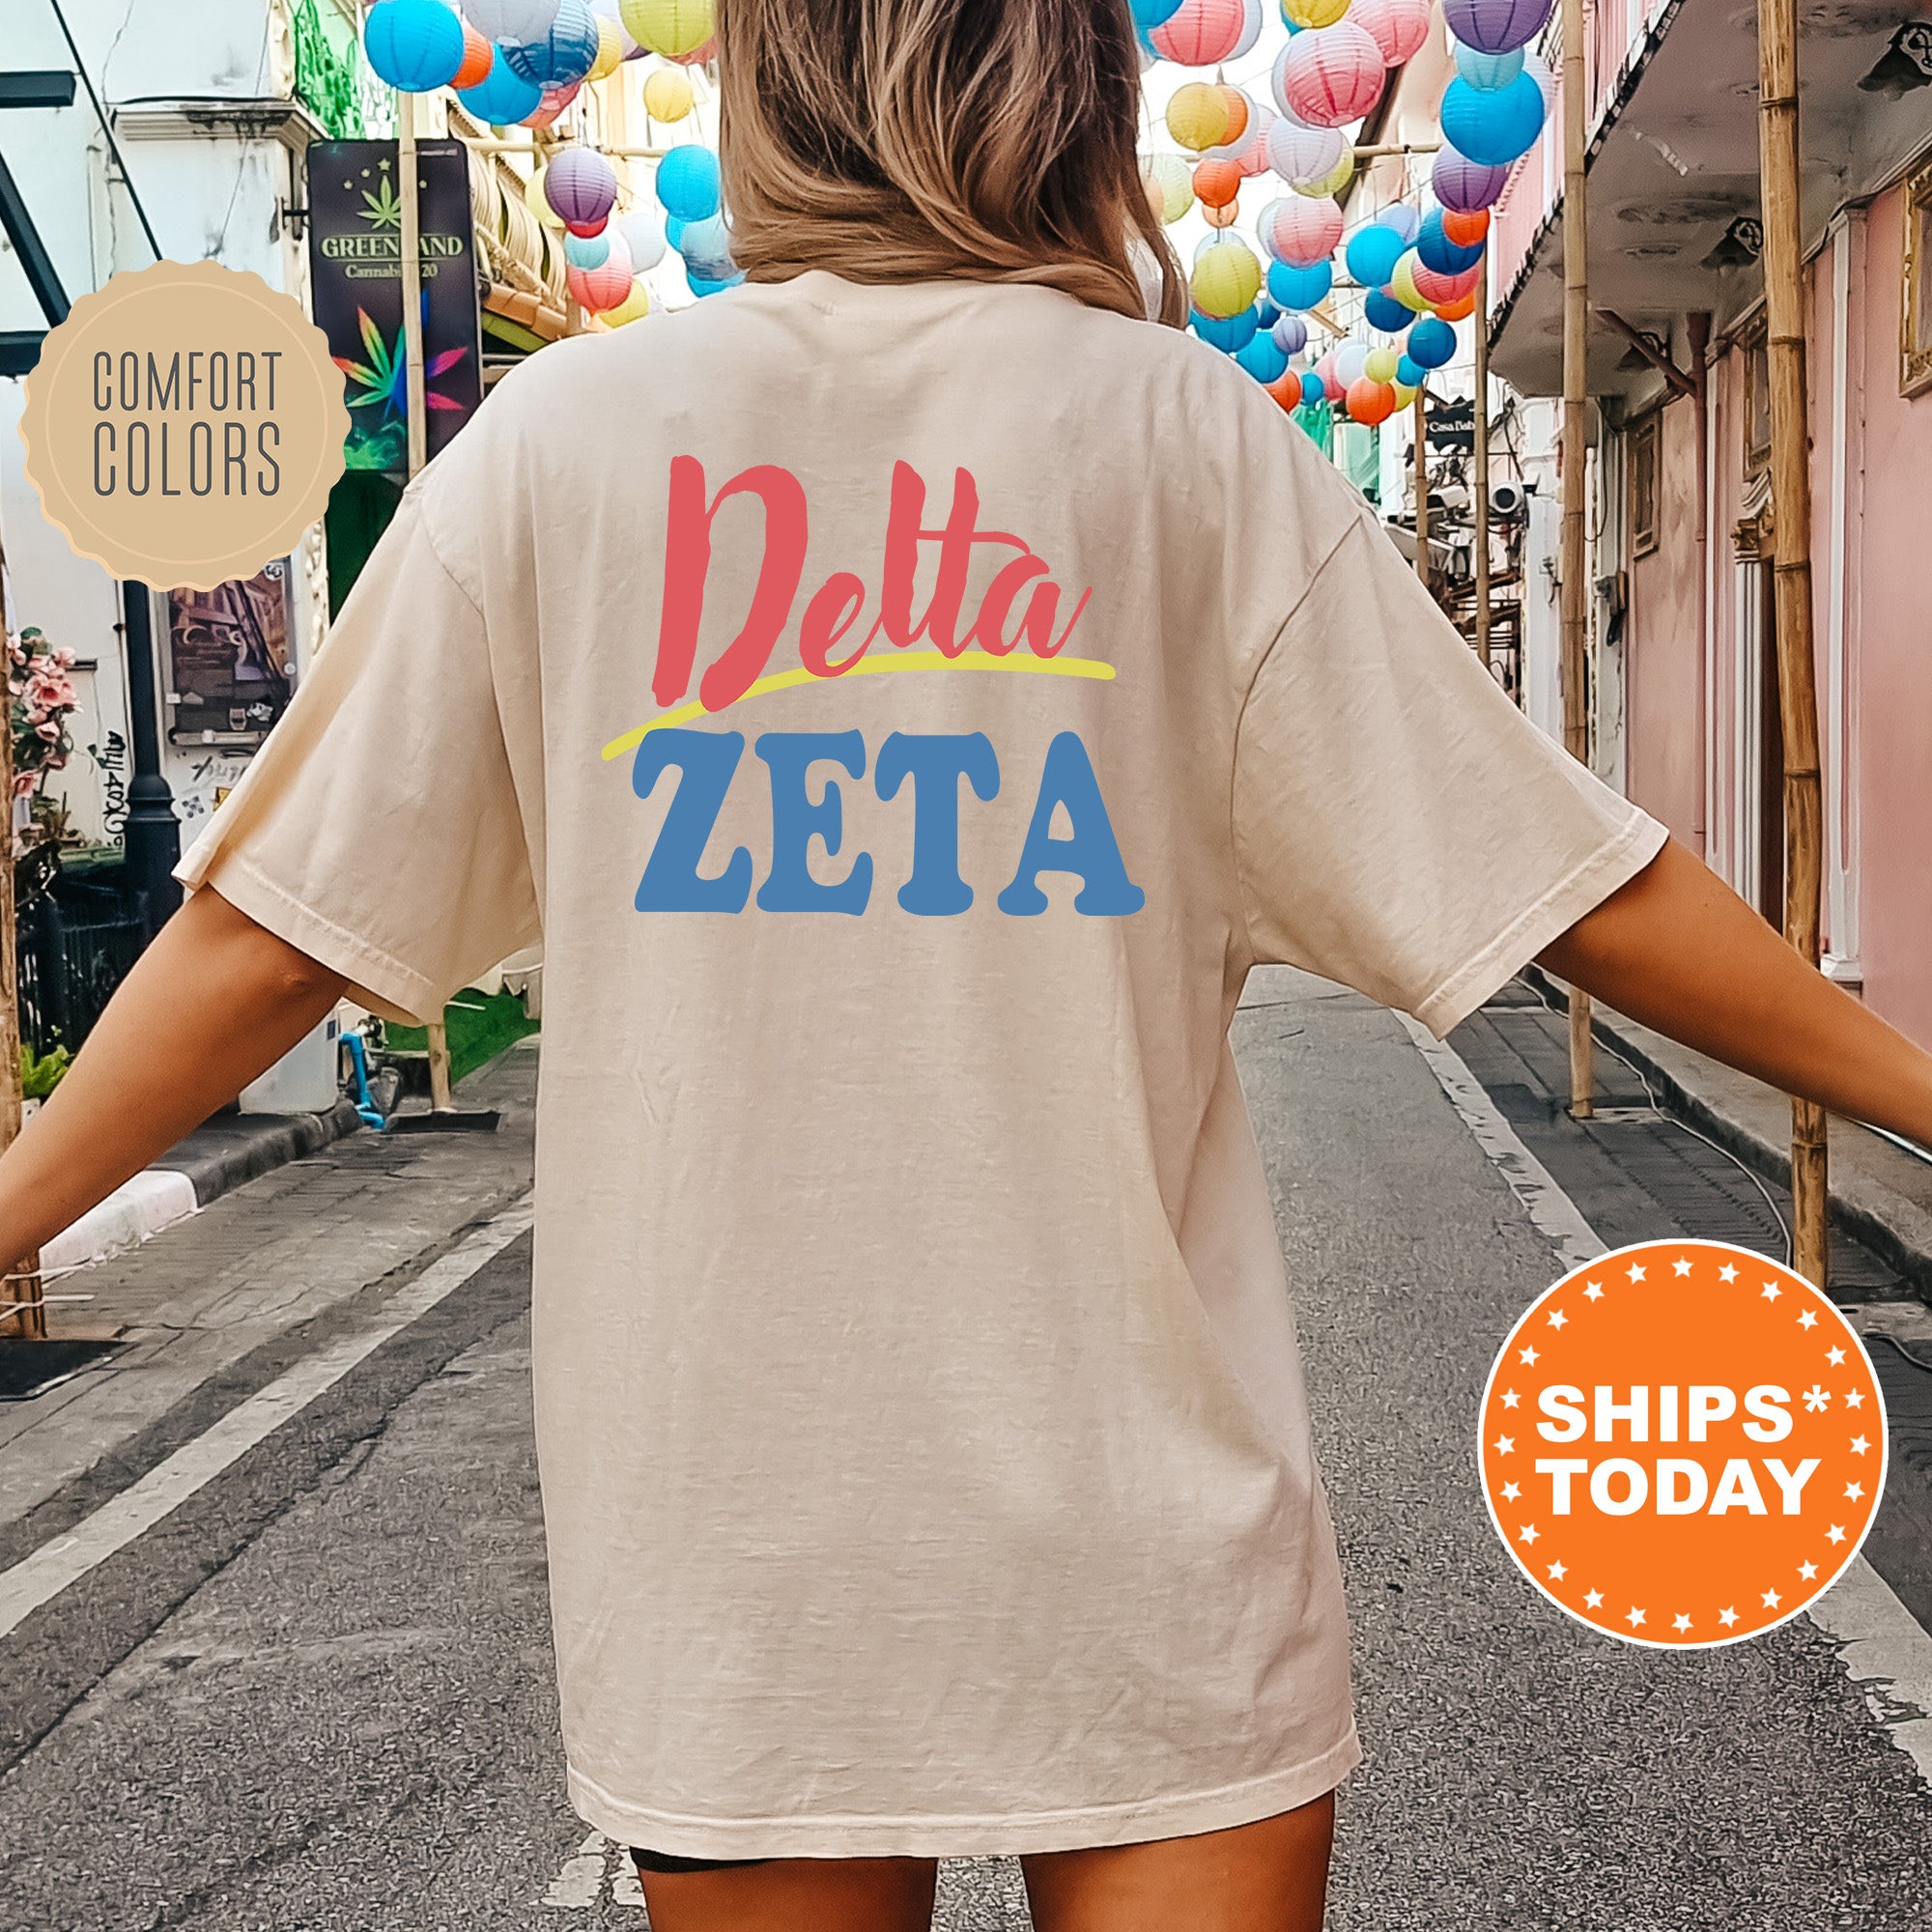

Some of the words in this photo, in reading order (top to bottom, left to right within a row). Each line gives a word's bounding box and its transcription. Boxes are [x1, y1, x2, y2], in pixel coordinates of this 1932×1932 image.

[321, 238, 464, 258] GREENAND
[421, 263, 439, 277] 20
[651, 454, 1094, 713] Delta
[632, 727, 1146, 917] ZETA
